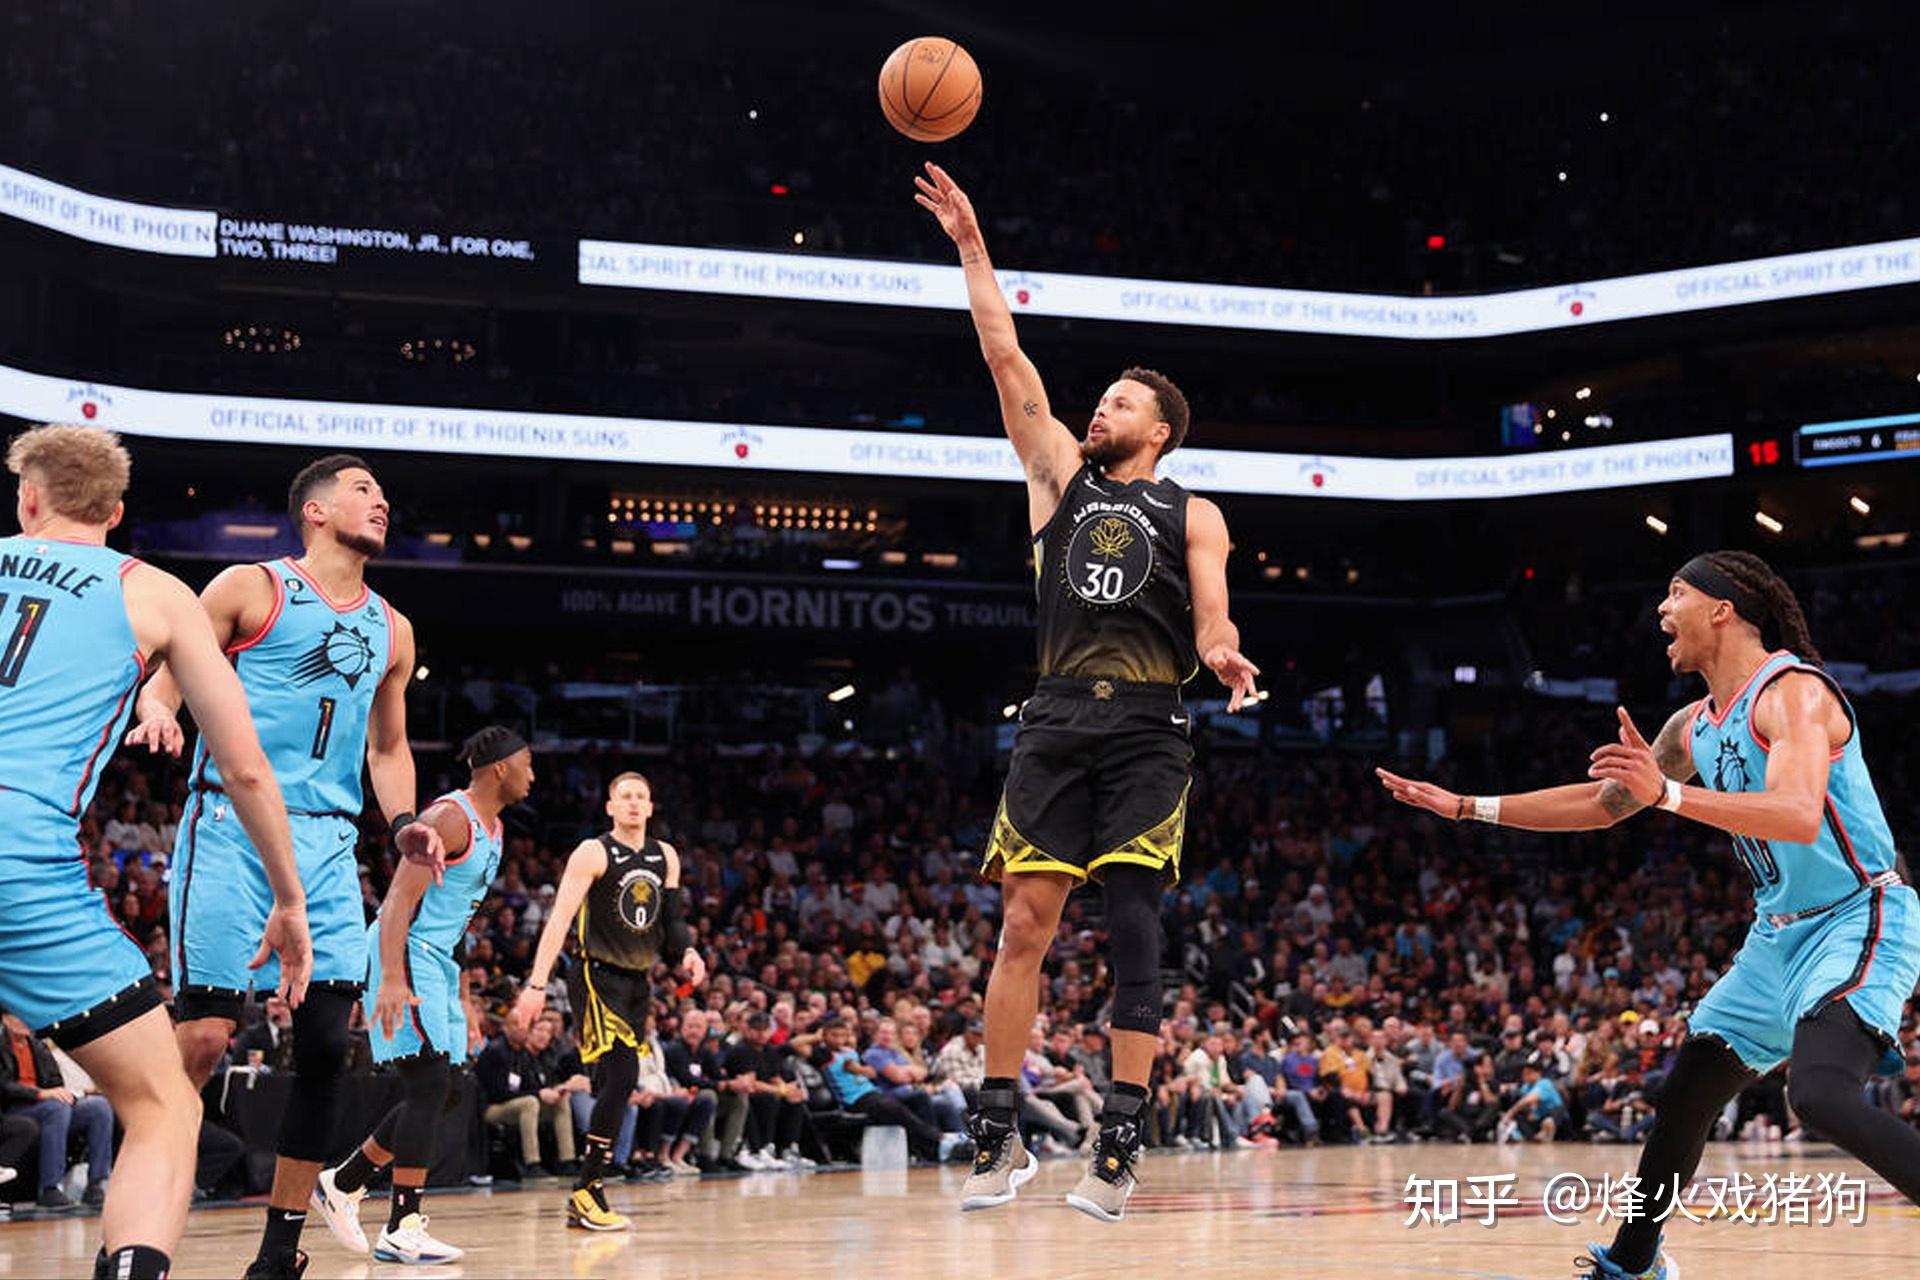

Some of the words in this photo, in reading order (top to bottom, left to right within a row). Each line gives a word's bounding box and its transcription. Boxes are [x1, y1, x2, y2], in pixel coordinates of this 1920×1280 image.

[1, 178, 55, 213] SPIRIT
[59, 200, 81, 219] OF
[88, 206, 125, 234] THE
[219, 218, 285, 241] DUANE
[287, 223, 414, 251] WASHINGTON,
[450, 235, 489, 257] FOR
[491, 238, 534, 261] ONE,
[220, 238, 268, 260] TWO,
[627, 254, 692, 276] SPIRIT
[698, 260, 721, 278] OF
[732, 263, 770, 284] THE
[775, 265, 862, 289] PHOENIX
[867, 271, 923, 293] SUNS
[1675, 272, 1762, 300] OFFICIAL
[1771, 260, 1834, 288] SPIRIT
[1841, 258, 1865, 279] OF
[1873, 251, 1911, 273] THE
[1119, 290, 1201, 312] OFFICIAL
[1208, 296, 1266, 317] SPIRIT
[1271, 302, 1294, 319] OF
[1300, 302, 1334, 323] THE
[1340, 304, 1419, 326] PHOENIX
[1424, 309, 1479, 328] SUNS
[210, 407, 308, 433] OFFICIAL
[316, 413, 386, 436] SPIRIT
[392, 417, 417, 437] OF
[428, 419, 464, 441] THE
[474, 421, 565, 446] PHOENIX
[572, 428, 630, 450] SUNS
[850, 442, 938, 466] OFFICIAL
[944, 446, 1003, 468] SPIRIT
[1165, 460, 1217, 478] SUNS
[1414, 468, 1499, 488] OFFICIAL
[1506, 460, 1567, 483] SPIRIT
[1572, 457, 1596, 478] OF
[1603, 454, 1638, 475] THE
[1644, 445, 1729, 468] PHOENIX
[1748, 439, 1780, 466] 15
[1080, 562, 1124, 600] 30
[689, 583, 935, 631] HORNITOS
[310, 696, 337, 761] 1
[635, 906, 647, 929] 0
